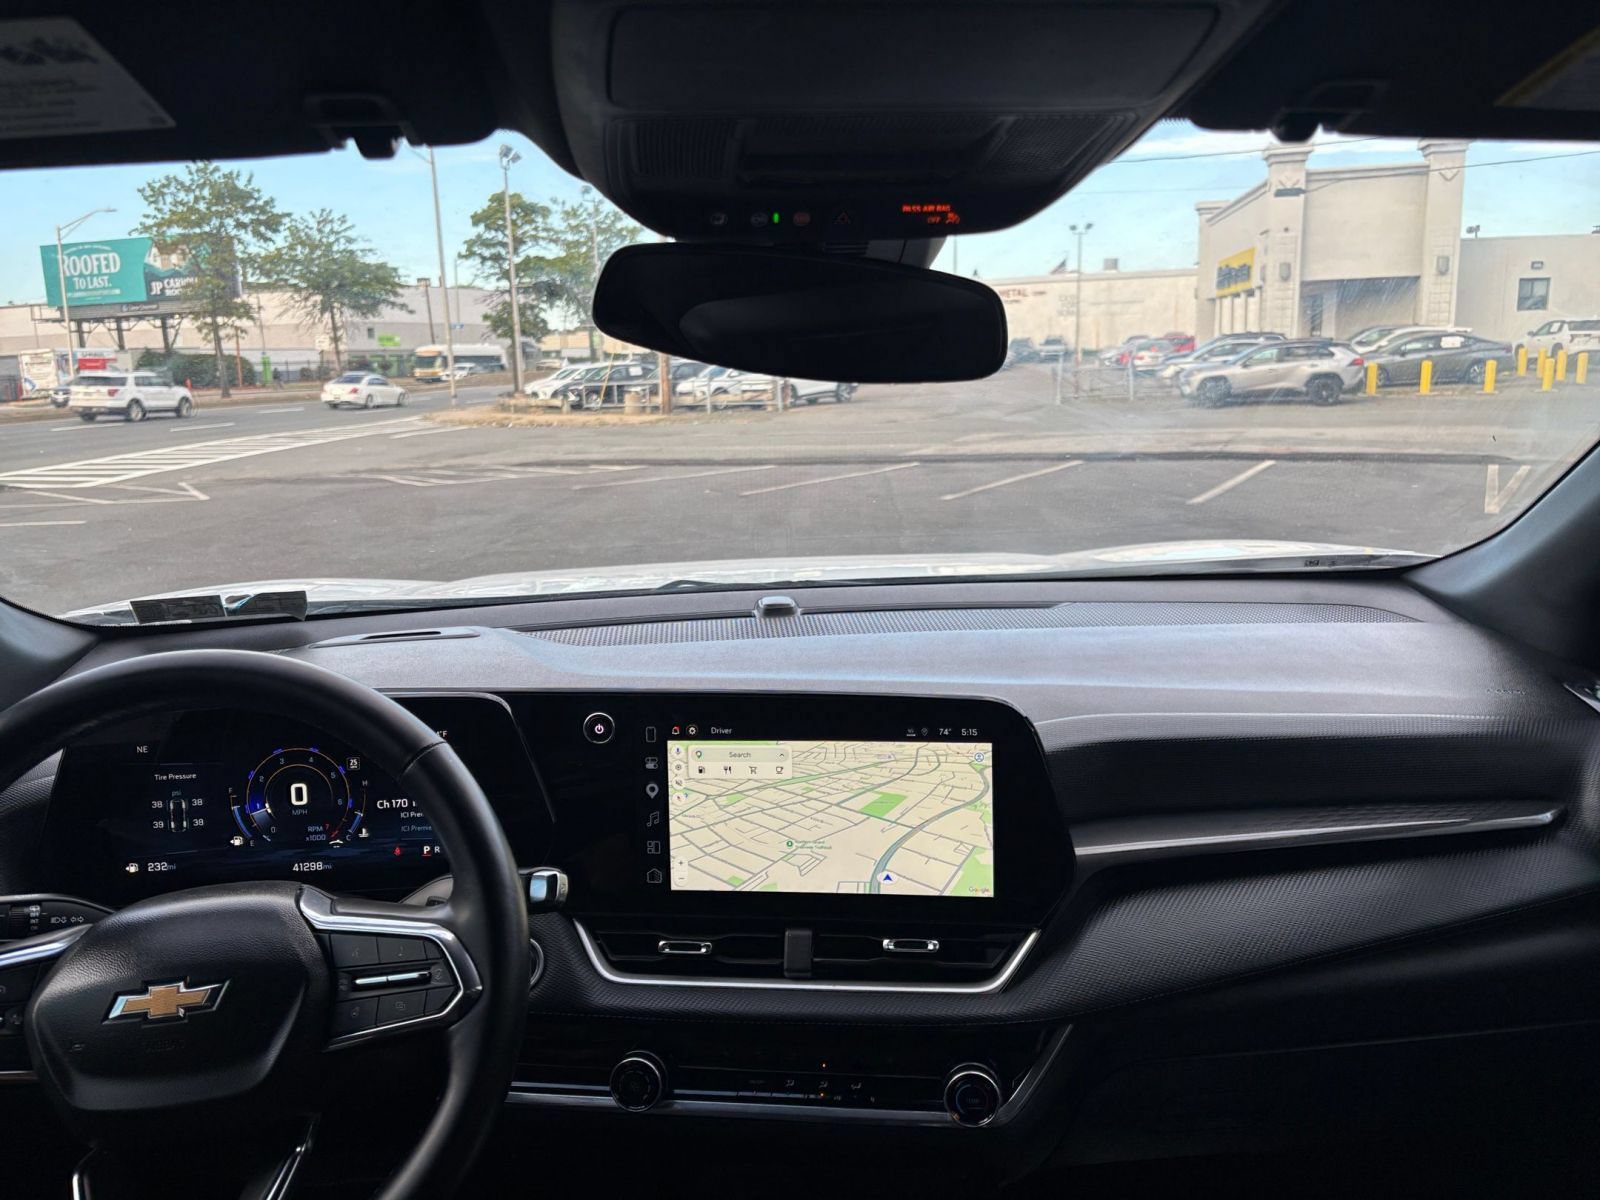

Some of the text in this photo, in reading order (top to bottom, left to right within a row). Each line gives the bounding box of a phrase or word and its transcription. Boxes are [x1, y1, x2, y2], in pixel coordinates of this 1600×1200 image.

[60, 251, 121, 277] ROOFED
[72, 276, 86, 291] TO
[150, 281, 163, 296] JP
[710, 726, 733, 735] Driver
[961, 728, 979, 737] 5:15
[136, 745, 149, 754] NE
[728, 751, 752, 759] Search
[349, 758, 358, 766] 25
[154, 772, 197, 781] Tire Pressure
[290, 783, 308, 806] 0
[151, 799, 203, 809] 38 38
[376, 798, 409, 809] Ch 170
[152, 818, 204, 829] 39 38
[307, 825, 324, 833] RPM
[423, 845, 441, 855] P R
